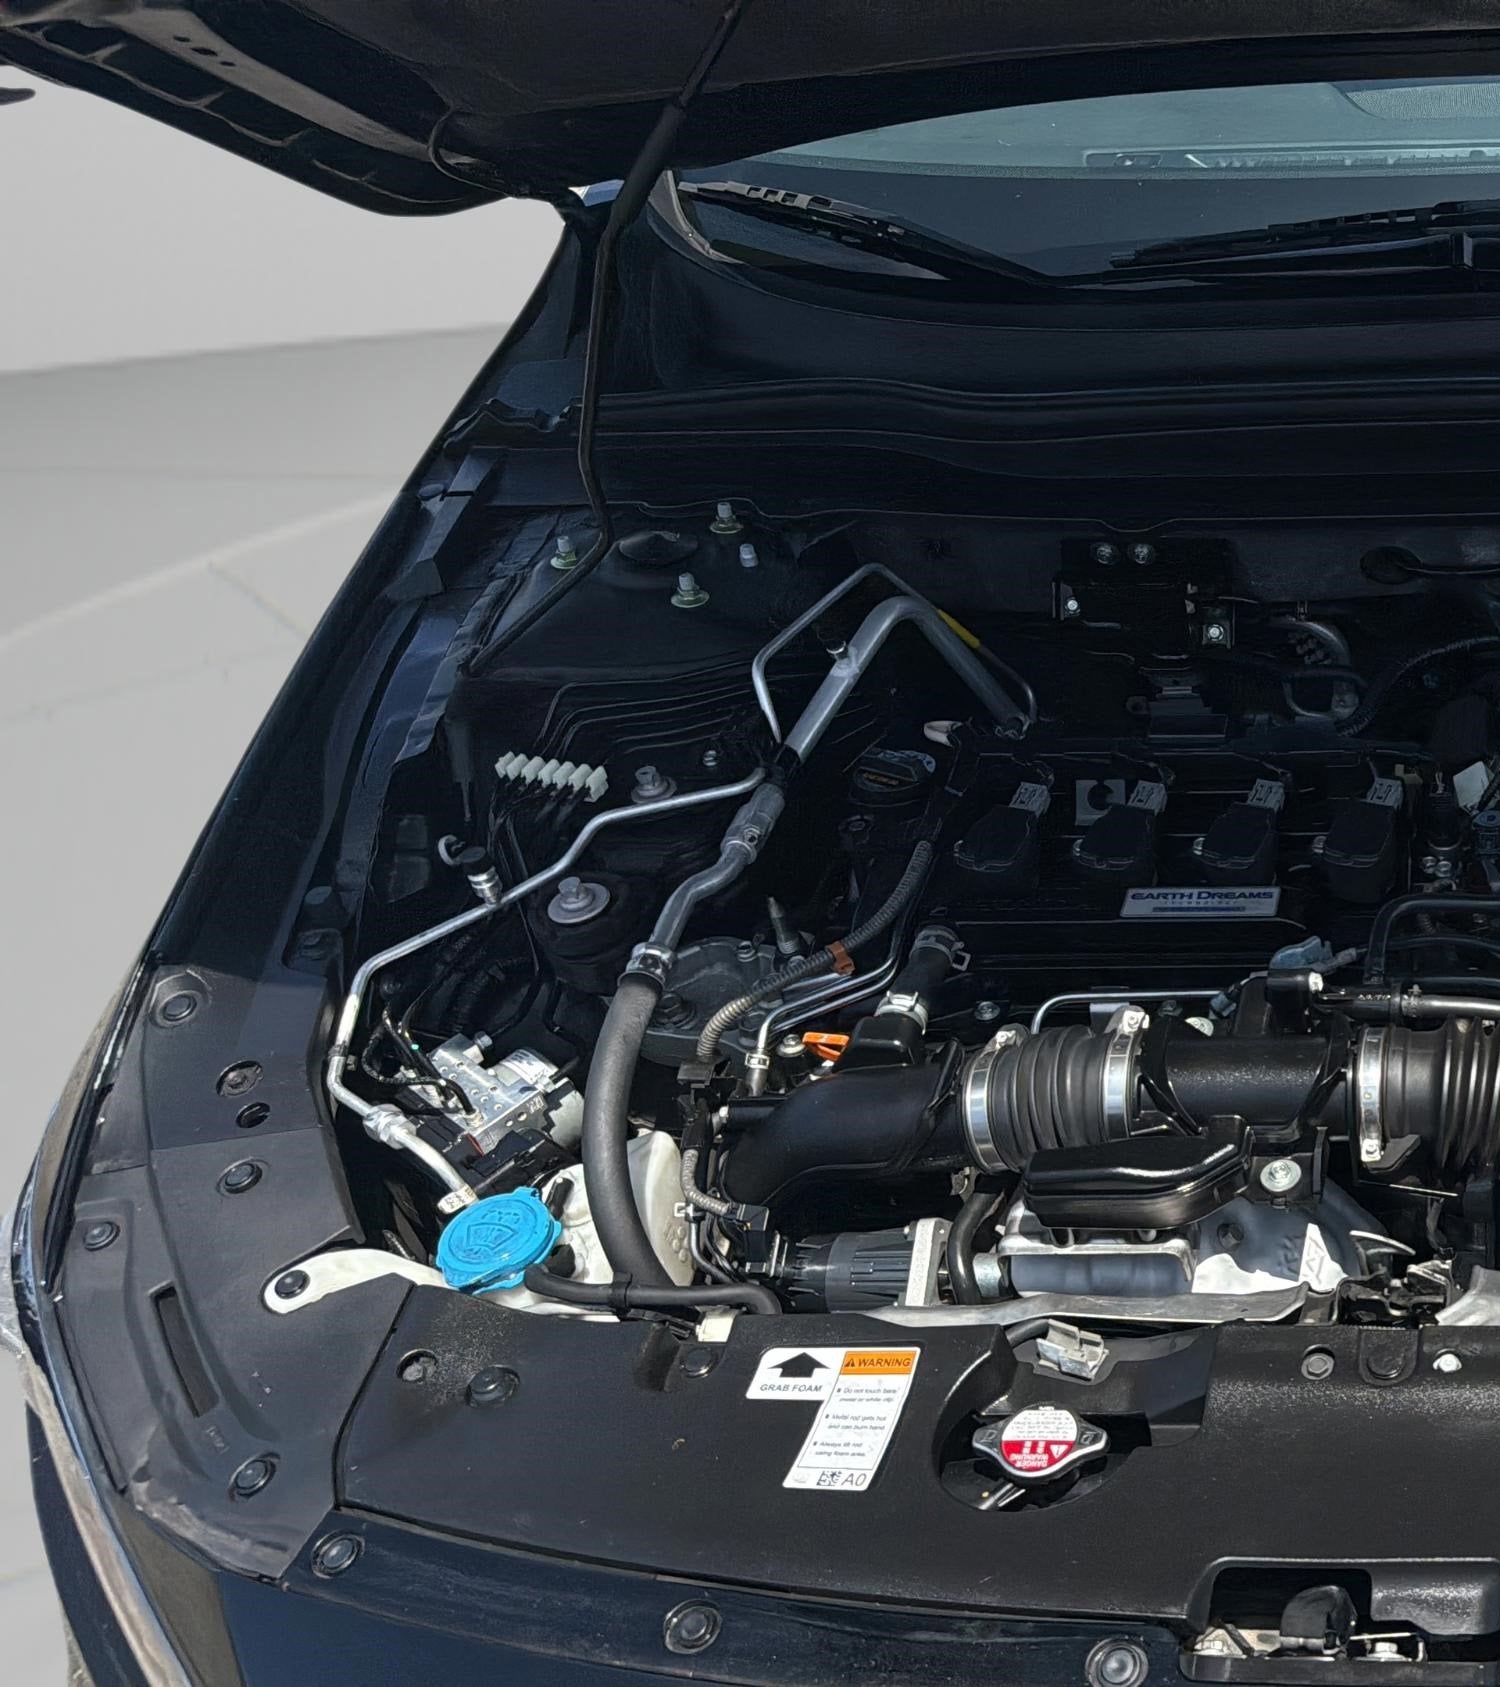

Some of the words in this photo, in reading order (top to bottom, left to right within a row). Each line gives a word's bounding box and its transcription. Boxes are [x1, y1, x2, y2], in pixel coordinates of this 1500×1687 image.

[1130, 891, 1193, 900] EARTH
[1197, 890, 1274, 900] DREAMS
[857, 1357, 912, 1368] WARNING
[759, 1383, 790, 1393] GRAB
[791, 1383, 822, 1393] FOAM
[840, 1472, 868, 1487] A0
